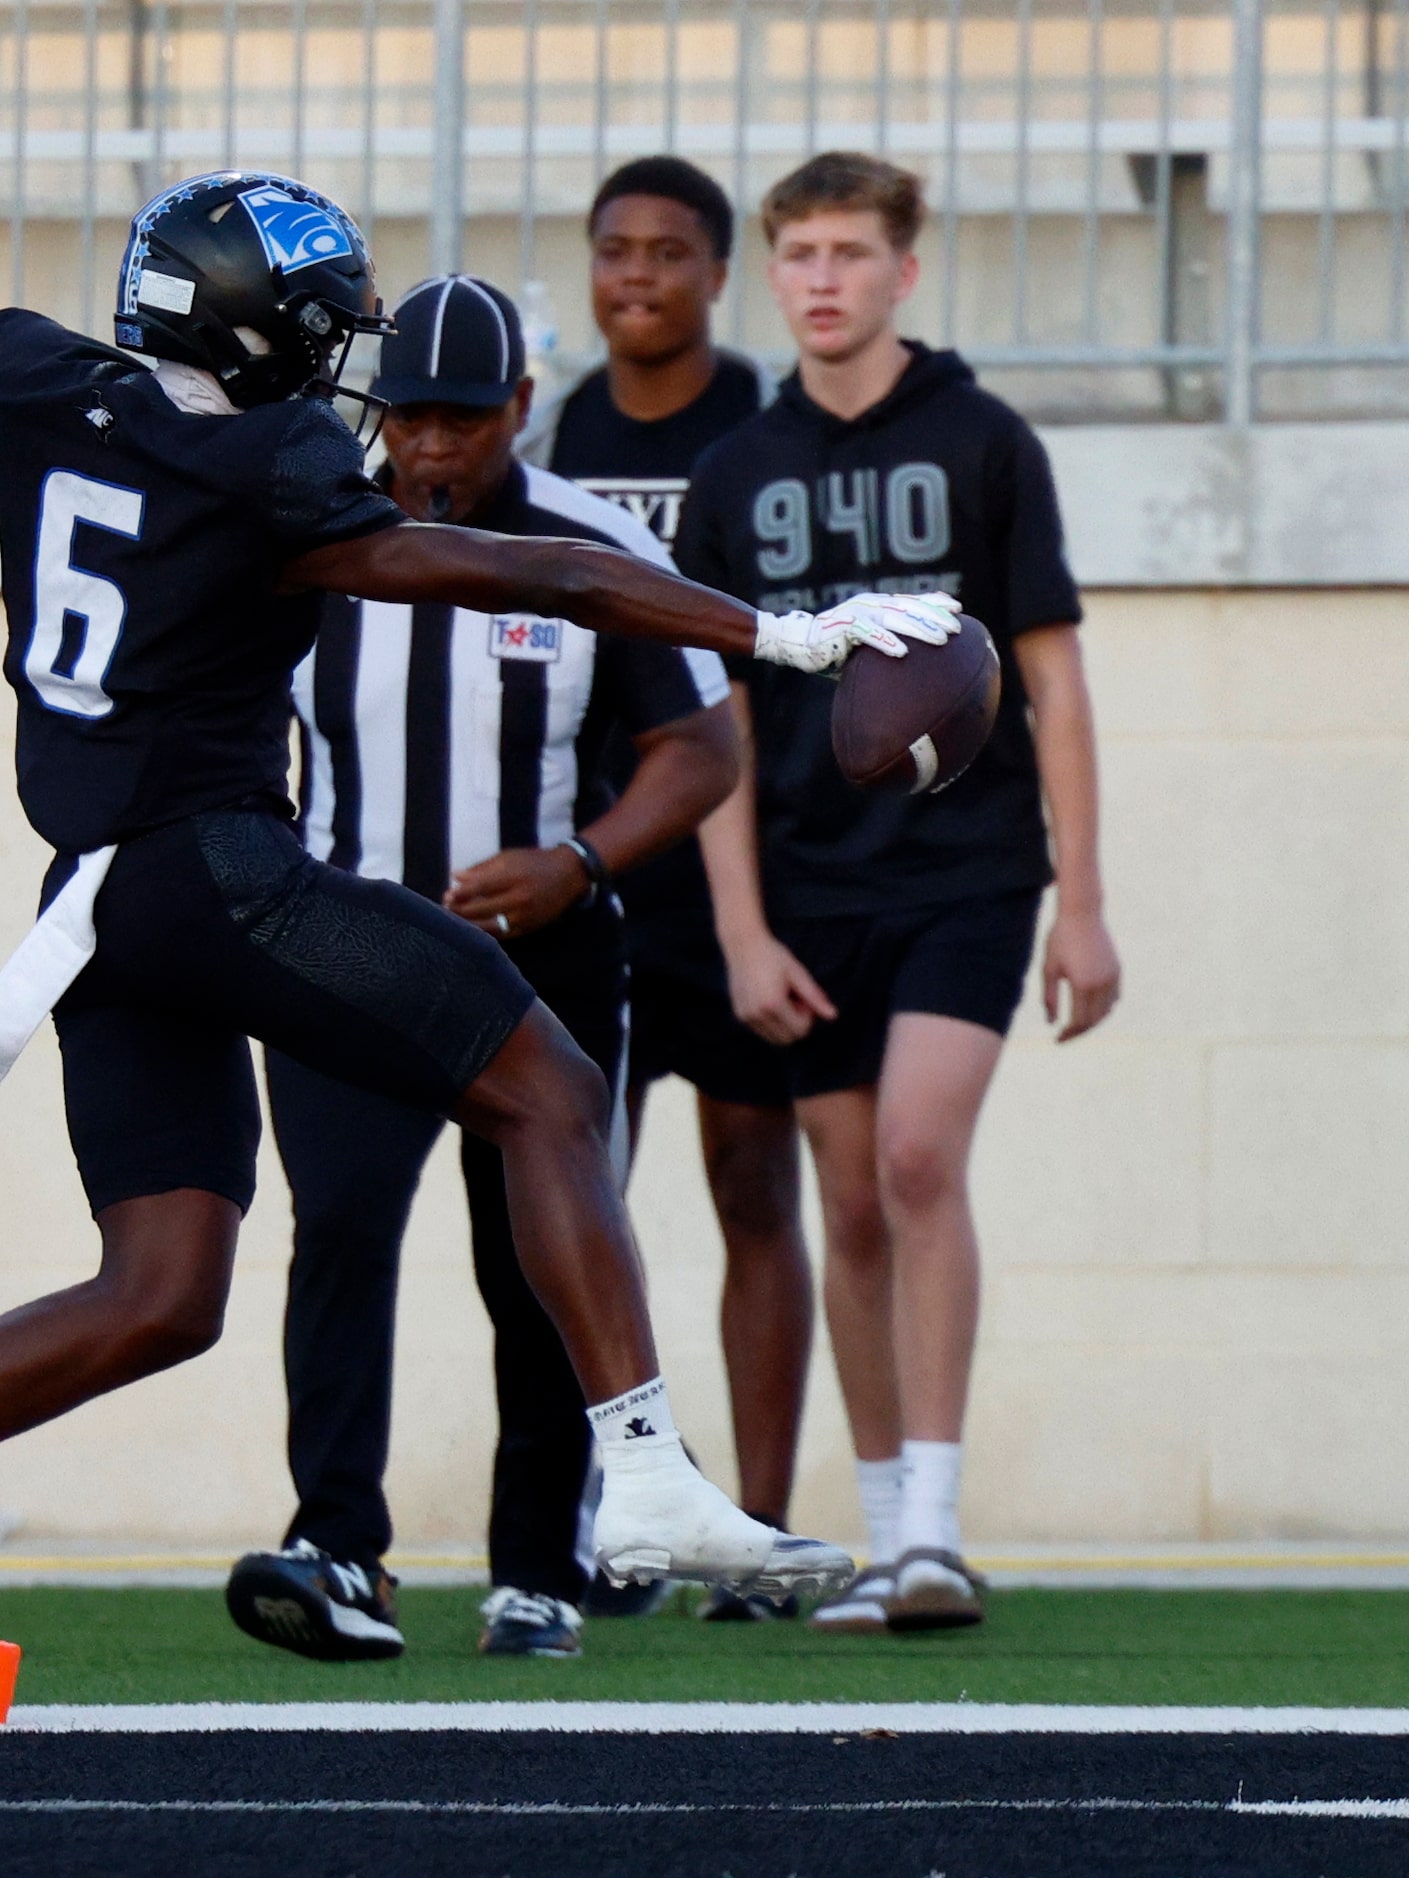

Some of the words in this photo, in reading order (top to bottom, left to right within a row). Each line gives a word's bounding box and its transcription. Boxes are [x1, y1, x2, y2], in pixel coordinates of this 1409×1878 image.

[753, 461, 951, 581] 940
[22, 466, 146, 720] 6
[496, 620, 556, 649] TSO
